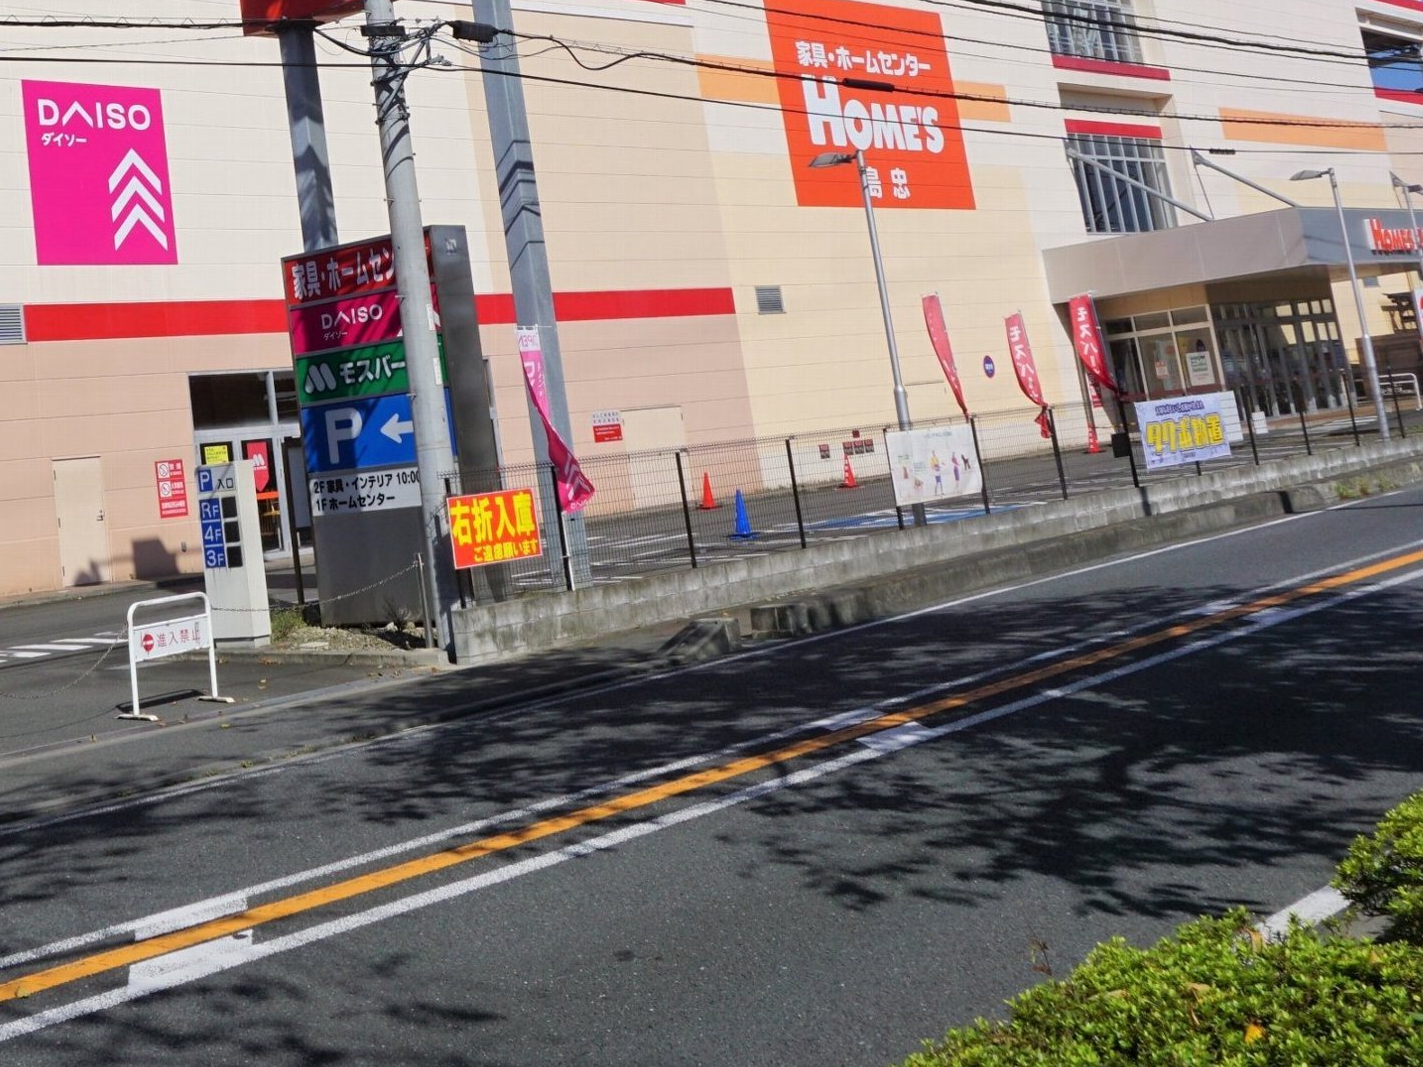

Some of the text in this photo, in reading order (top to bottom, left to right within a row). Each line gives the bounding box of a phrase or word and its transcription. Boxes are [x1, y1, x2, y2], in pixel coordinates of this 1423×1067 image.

[795, 41, 931, 77] 家具・ホームセンター
[37, 98, 151, 131] DAISO
[800, 74, 945, 154] HOME'S
[41, 133, 87, 148] ダイソー
[320, 303, 383, 329] DAISO
[323, 331, 348, 341] ダイソー
[324, 406, 363, 465] P
[199, 472, 234, 491] P 入口
[313, 481, 325, 494] 2F
[201, 502, 220, 519] RF
[316, 493, 396, 511] 1F ホームセンター
[449, 492, 536, 546] 右折入庫
[204, 525, 222, 542] 4F
[206, 549, 225, 567] 3F
[156, 622, 201, 647] 進入禁止
